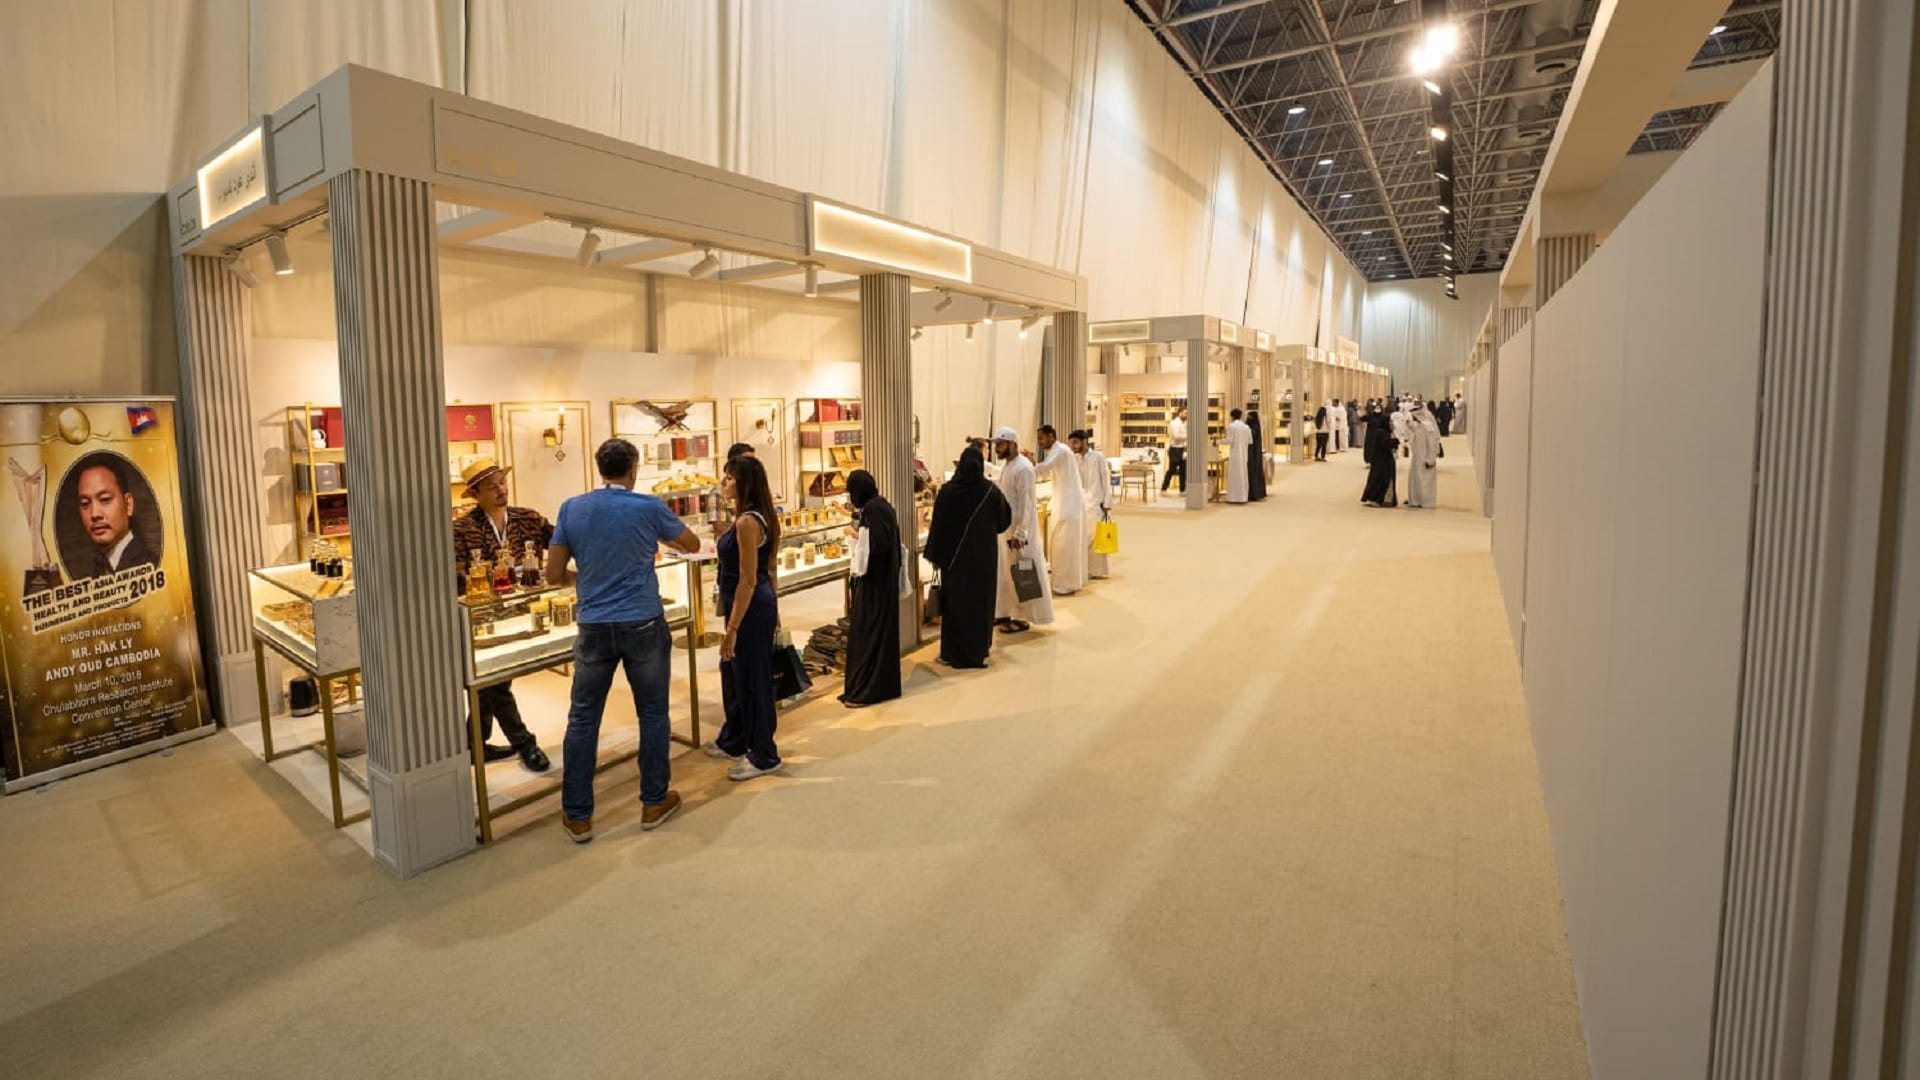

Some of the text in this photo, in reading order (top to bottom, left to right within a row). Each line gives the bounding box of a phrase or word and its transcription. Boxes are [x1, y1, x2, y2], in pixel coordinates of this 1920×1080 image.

[23, 565, 152, 611] THE BEST ASIA AWARDS
[129, 571, 165, 599] 2018
[33, 585, 127, 620] HEALTH AND BEAUTY
[35, 597, 128, 631] BUSINESSES AND PRODUCTS
[60, 621, 142, 644] HONOR INVITATIONS
[71, 638, 133, 659] MR. HAK LY
[45, 648, 161, 681] ANDY OUD CAMBODIA
[42, 677, 173, 717] Chulabhorn Research Institute
[74, 679, 102, 693] March
[71, 704, 121, 724] Convention
[123, 698, 152, 711] Center
